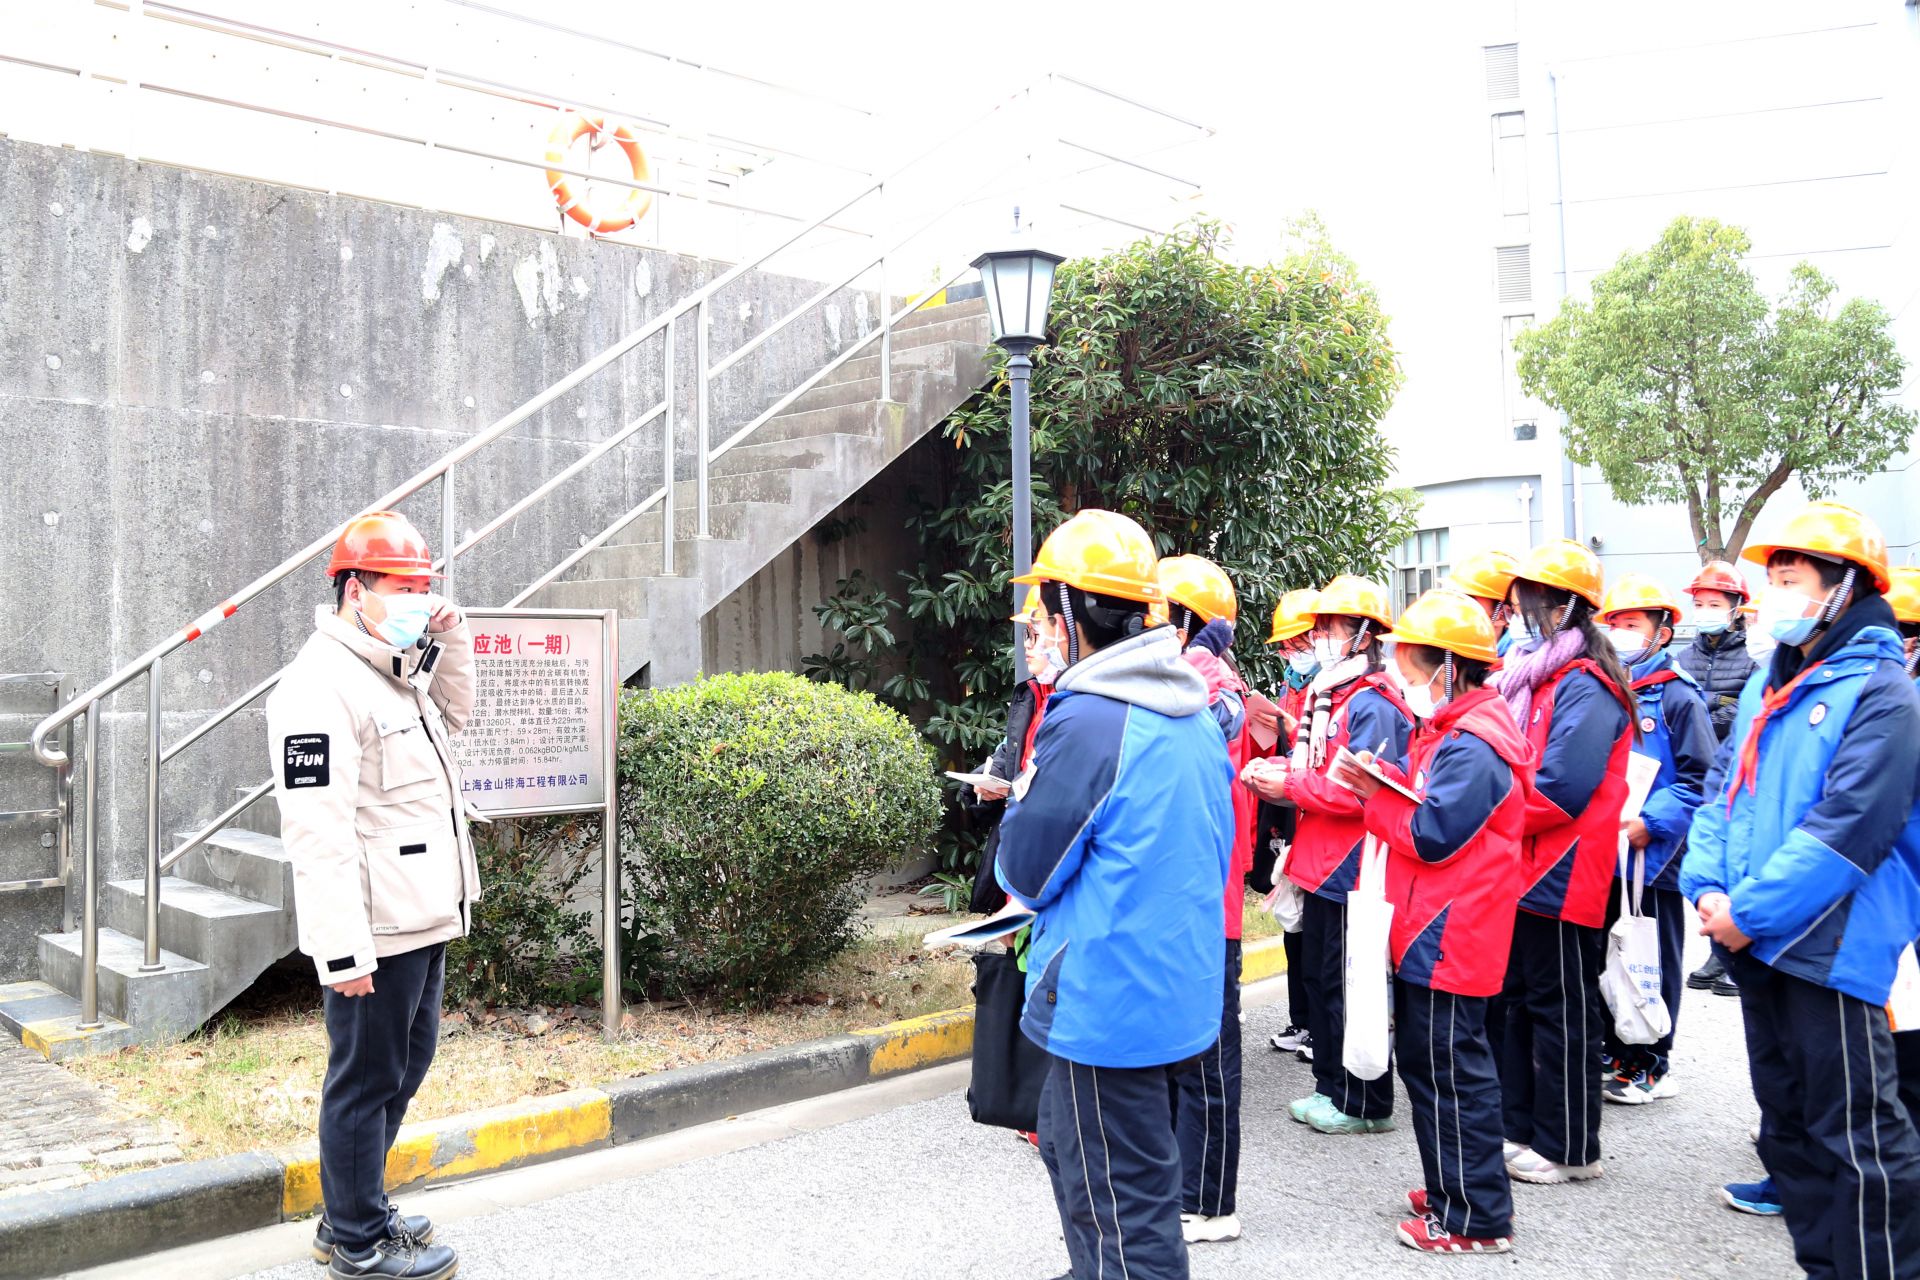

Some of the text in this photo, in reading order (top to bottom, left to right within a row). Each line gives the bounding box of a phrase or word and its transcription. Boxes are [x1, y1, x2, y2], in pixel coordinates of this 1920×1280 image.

[295, 753, 324, 767] FUN
[461, 774, 589, 792] 上海金山排海工程有限公司
